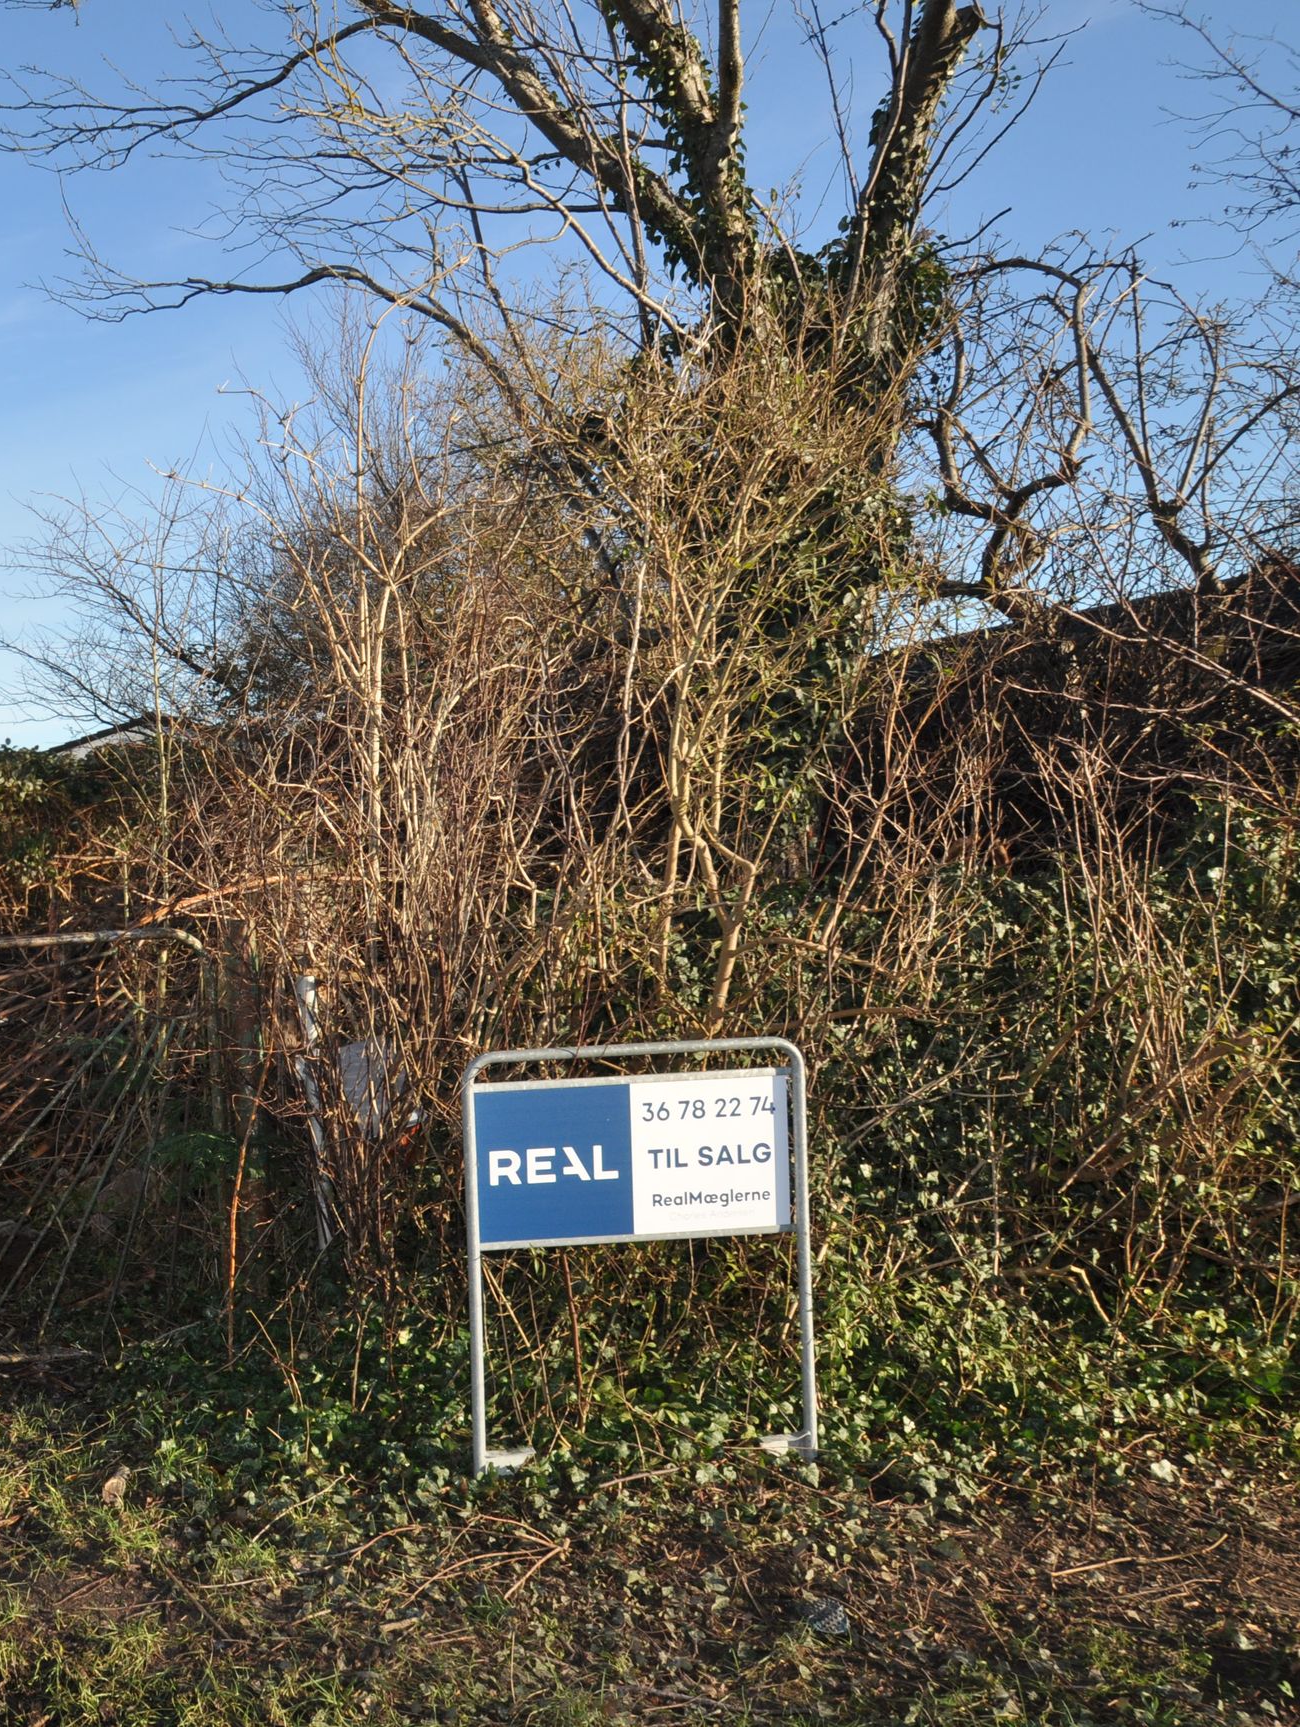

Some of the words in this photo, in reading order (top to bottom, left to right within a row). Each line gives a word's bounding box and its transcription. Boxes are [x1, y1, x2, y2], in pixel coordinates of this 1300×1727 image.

[642, 1101, 670, 1122] 36
[678, 1099, 706, 1120] 78
[714, 1097, 742, 1118] 22
[749, 1096, 775, 1116] 74
[488, 1144, 620, 1187] REAL
[647, 1147, 688, 1169] TIL
[697, 1142, 772, 1167] SALG
[652, 1188, 771, 1207] RealMæglerne
